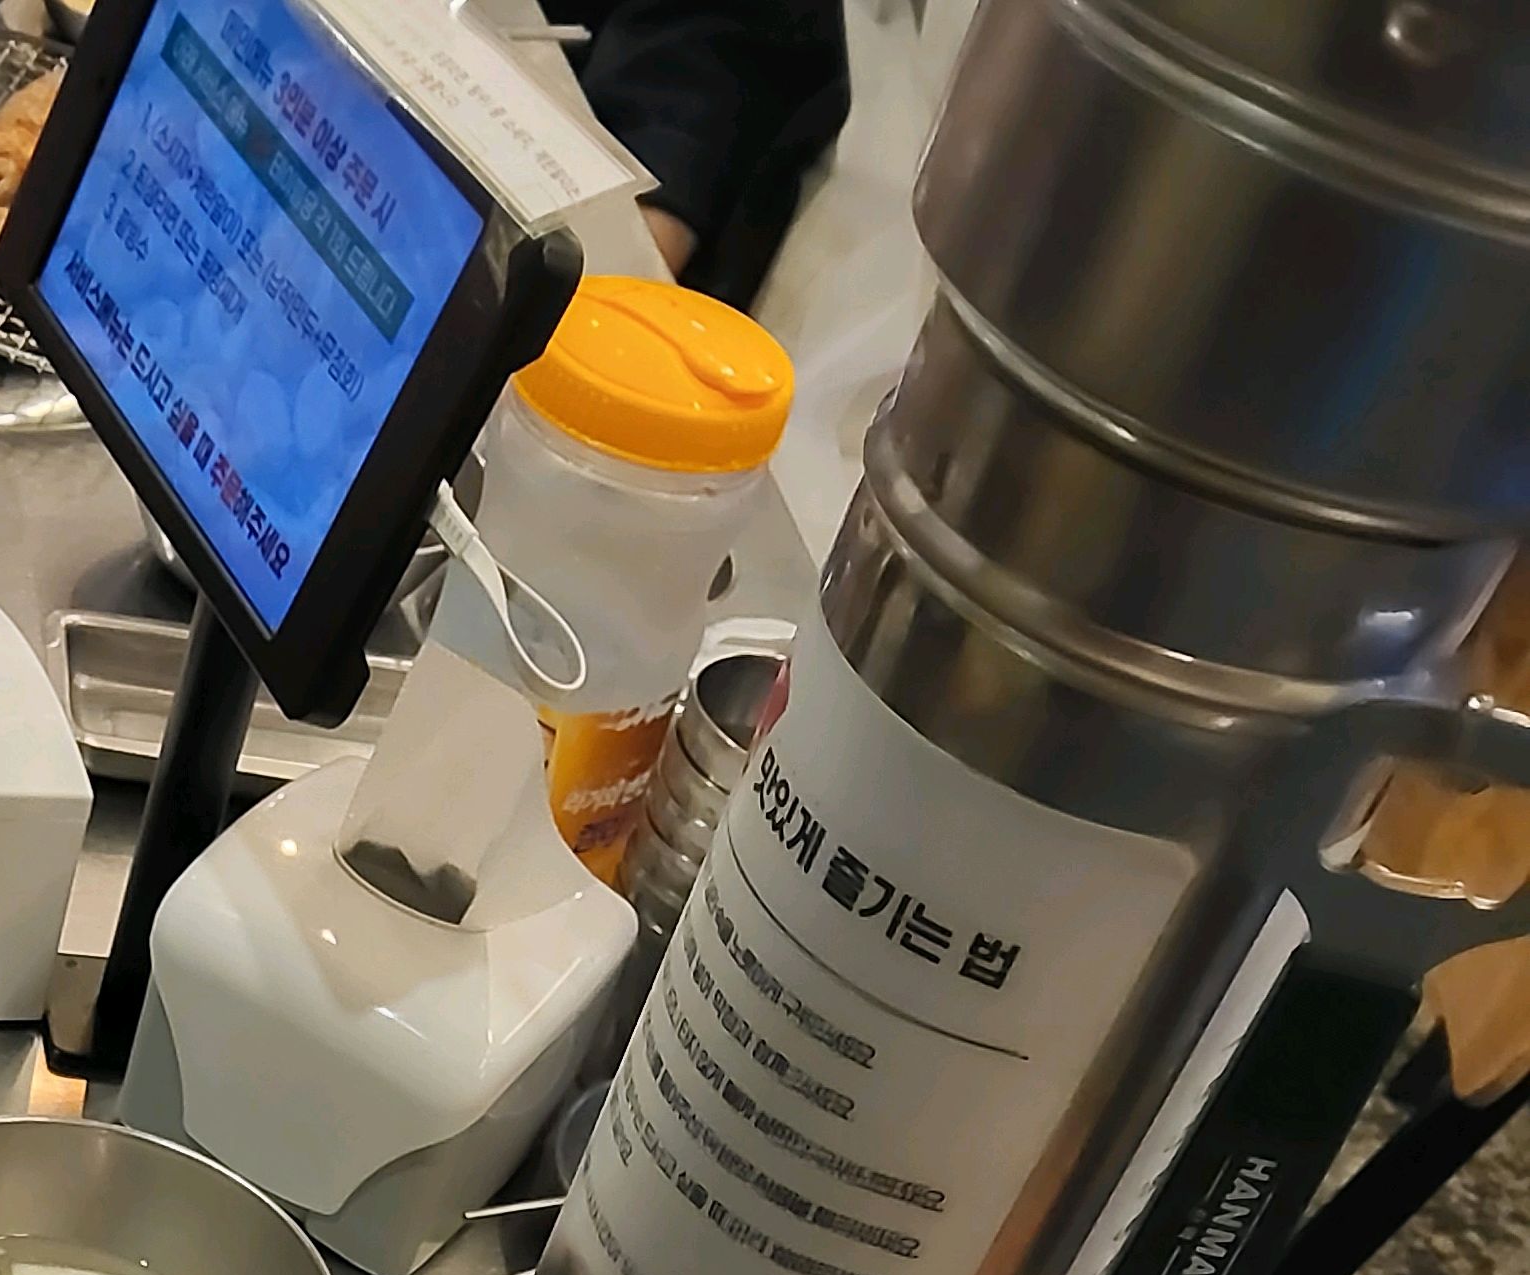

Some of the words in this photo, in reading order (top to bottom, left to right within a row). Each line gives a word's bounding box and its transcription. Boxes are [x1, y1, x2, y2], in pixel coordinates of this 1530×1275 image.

[274, 70, 317, 139] 3인분
[312, 118, 348, 172] 이상
[342, 151, 379, 211] 주문
[371, 191, 397, 233] 시
[174, 219, 202, 266] 또는
[237, 229, 263, 277] 또는
[130, 341, 174, 413] 드시고
[166, 396, 200, 451] 싶을
[191, 430, 216, 473] 때
[210, 452, 291, 581] 주문해주세요
[754, 745, 826, 875] 맛있게
[821, 844, 953, 965] 즐기는
[959, 930, 1021, 991] 법
